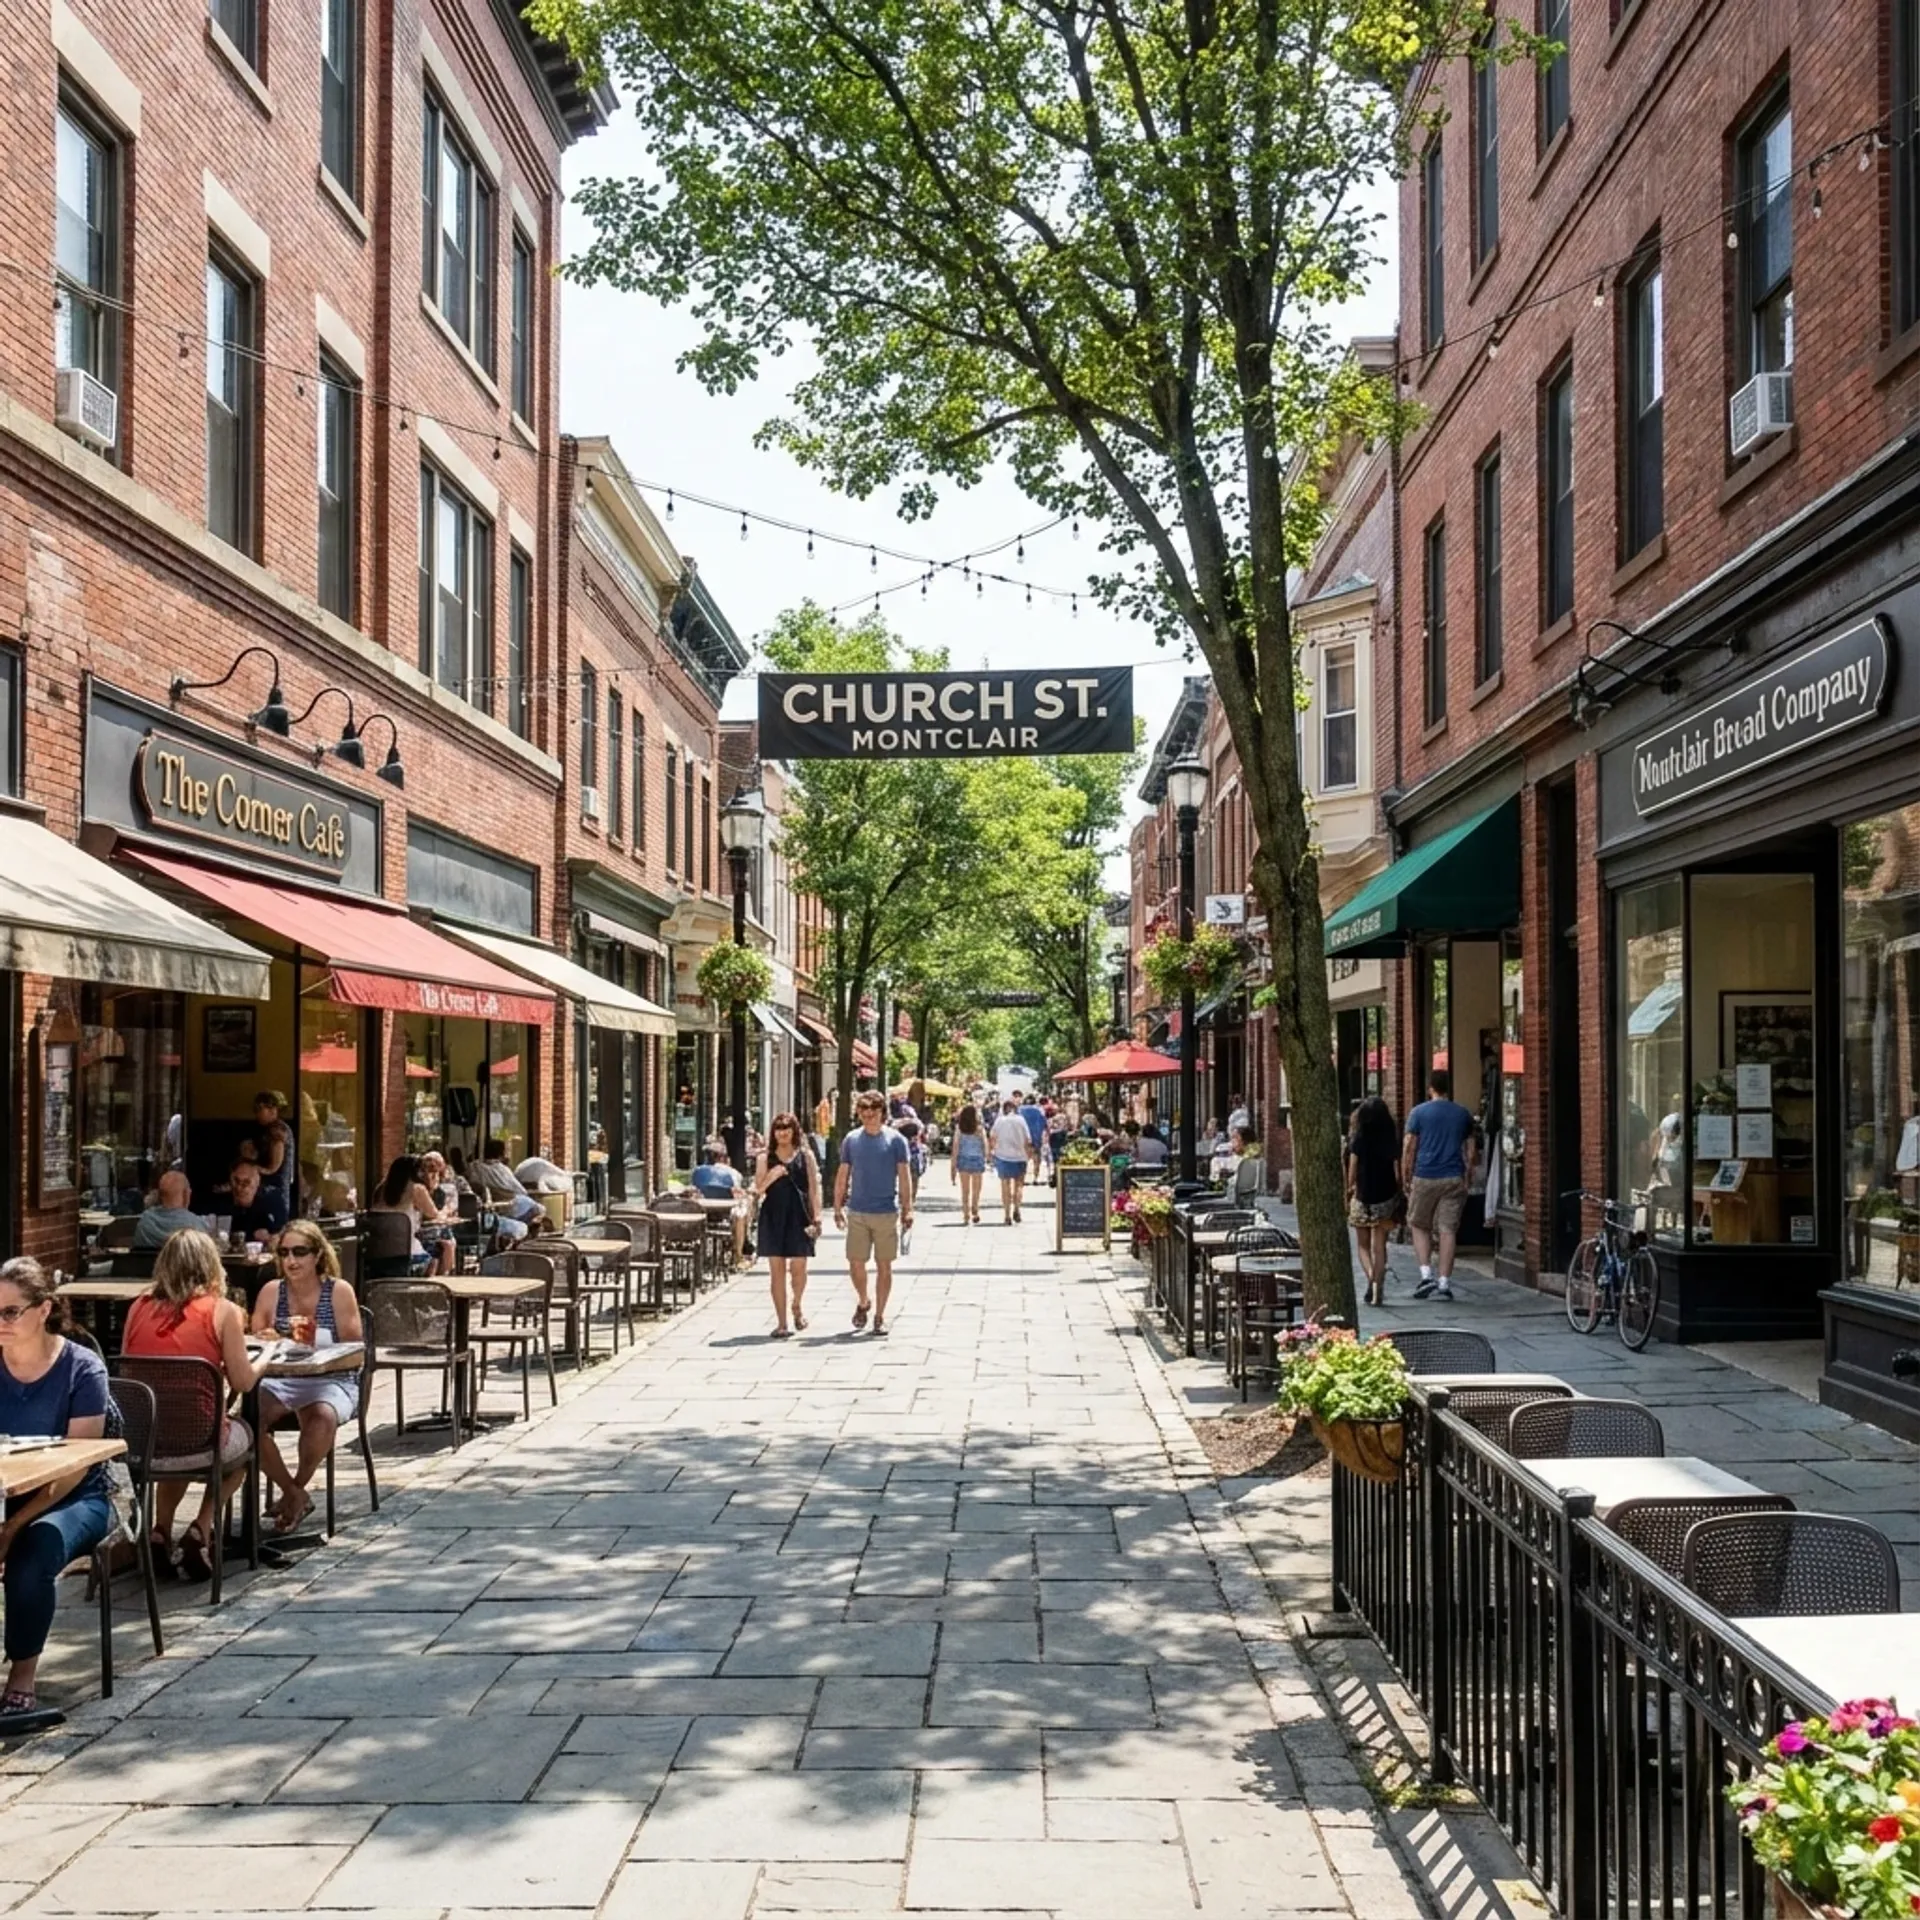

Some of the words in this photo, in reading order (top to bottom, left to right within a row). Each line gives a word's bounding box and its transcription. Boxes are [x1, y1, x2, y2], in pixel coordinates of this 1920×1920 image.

[782, 679, 1015, 724] CHURCH
[1034, 678, 1108, 720] ST.
[1638, 729, 1711, 795] Montclair
[1713, 693, 1768, 760] Bread
[1771, 655, 1872, 732] Company
[852, 726, 1039, 752] MONTCLAIR
[157, 749, 210, 817] The
[215, 772, 295, 842] Corner
